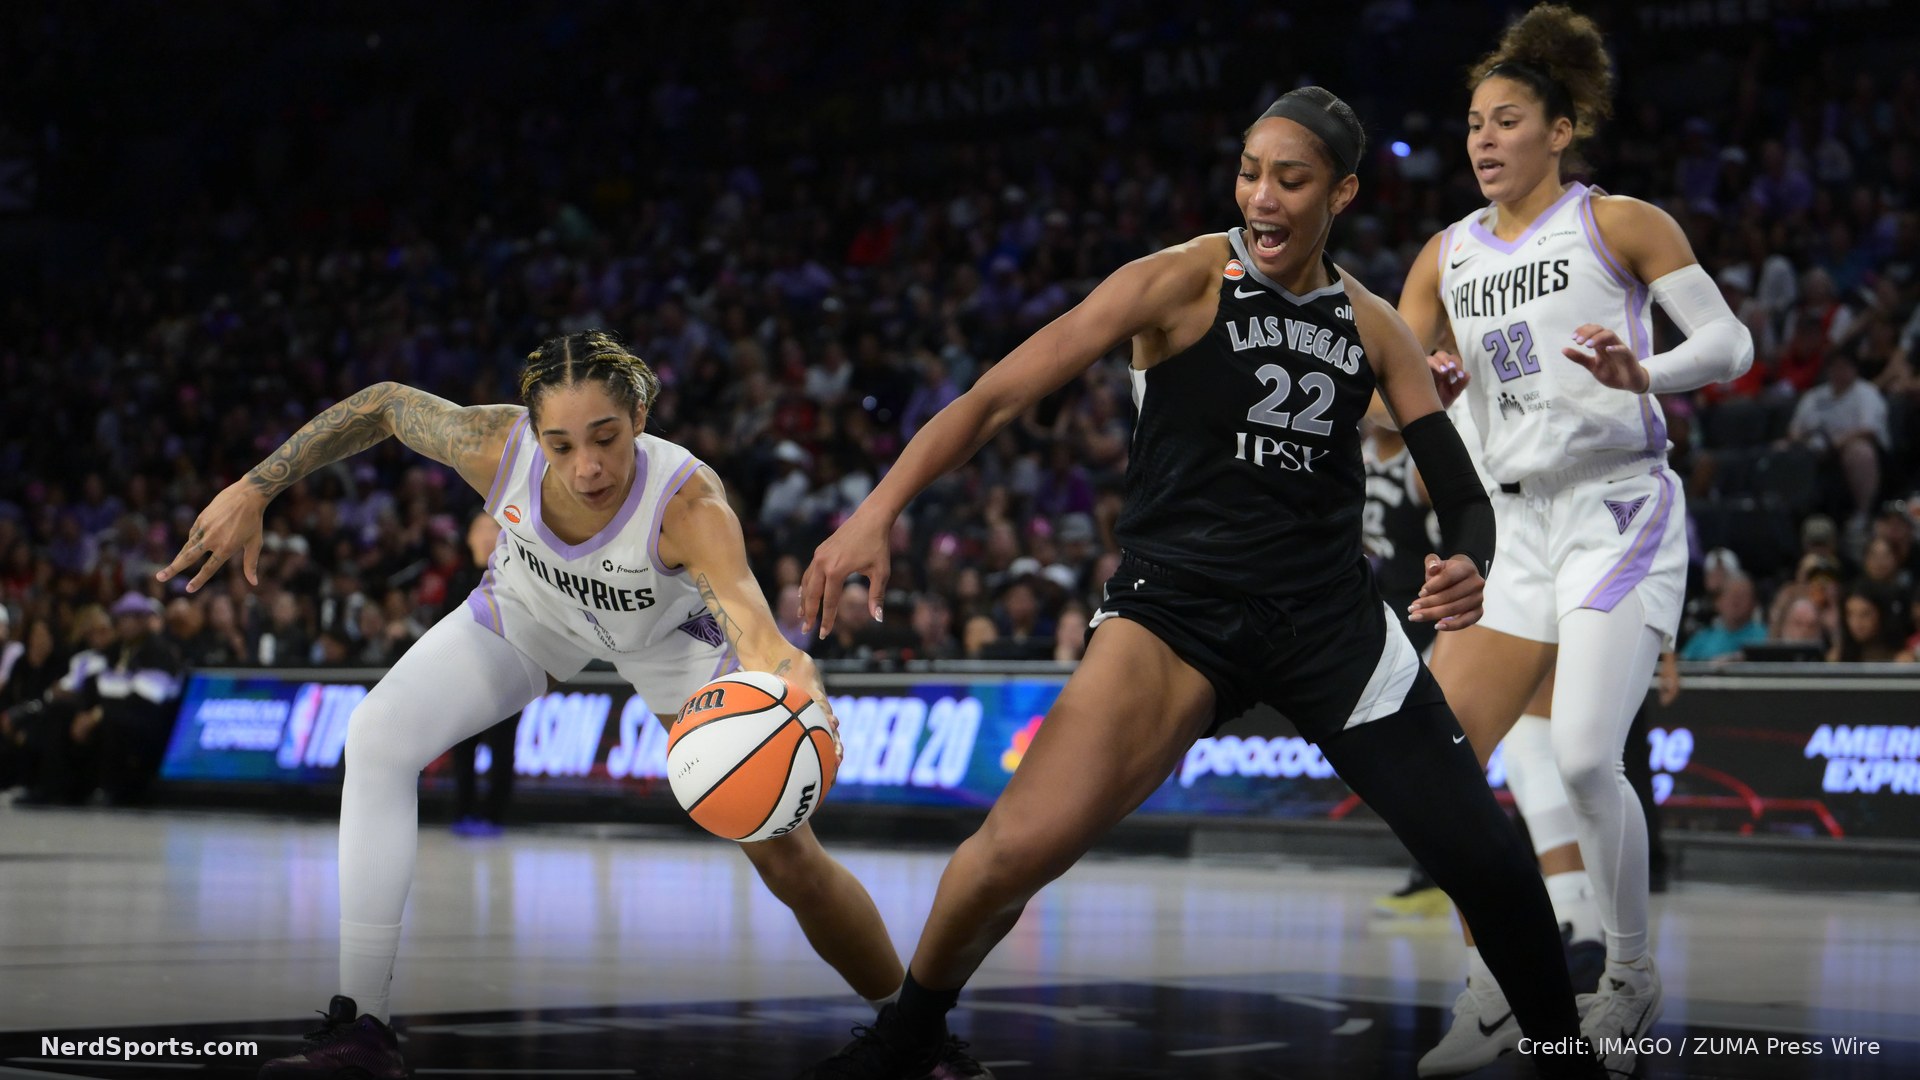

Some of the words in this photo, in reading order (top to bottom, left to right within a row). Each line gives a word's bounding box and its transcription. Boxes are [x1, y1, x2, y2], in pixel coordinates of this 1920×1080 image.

[882, 59, 1107, 124] MANDALA
[1335, 304, 1354, 321] all
[1451, 259, 1569, 319] VALKYRIES
[1226, 316, 1282, 352] LAS
[1285, 319, 1363, 375] VEGAS
[1482, 320, 1542, 383] 22
[1247, 363, 1336, 436] 22
[1235, 432, 1331, 473] IPSY
[514, 539, 656, 612] VALKYRIES
[616, 564, 649, 574] freedom
[1180, 735, 1336, 789] peacoc
